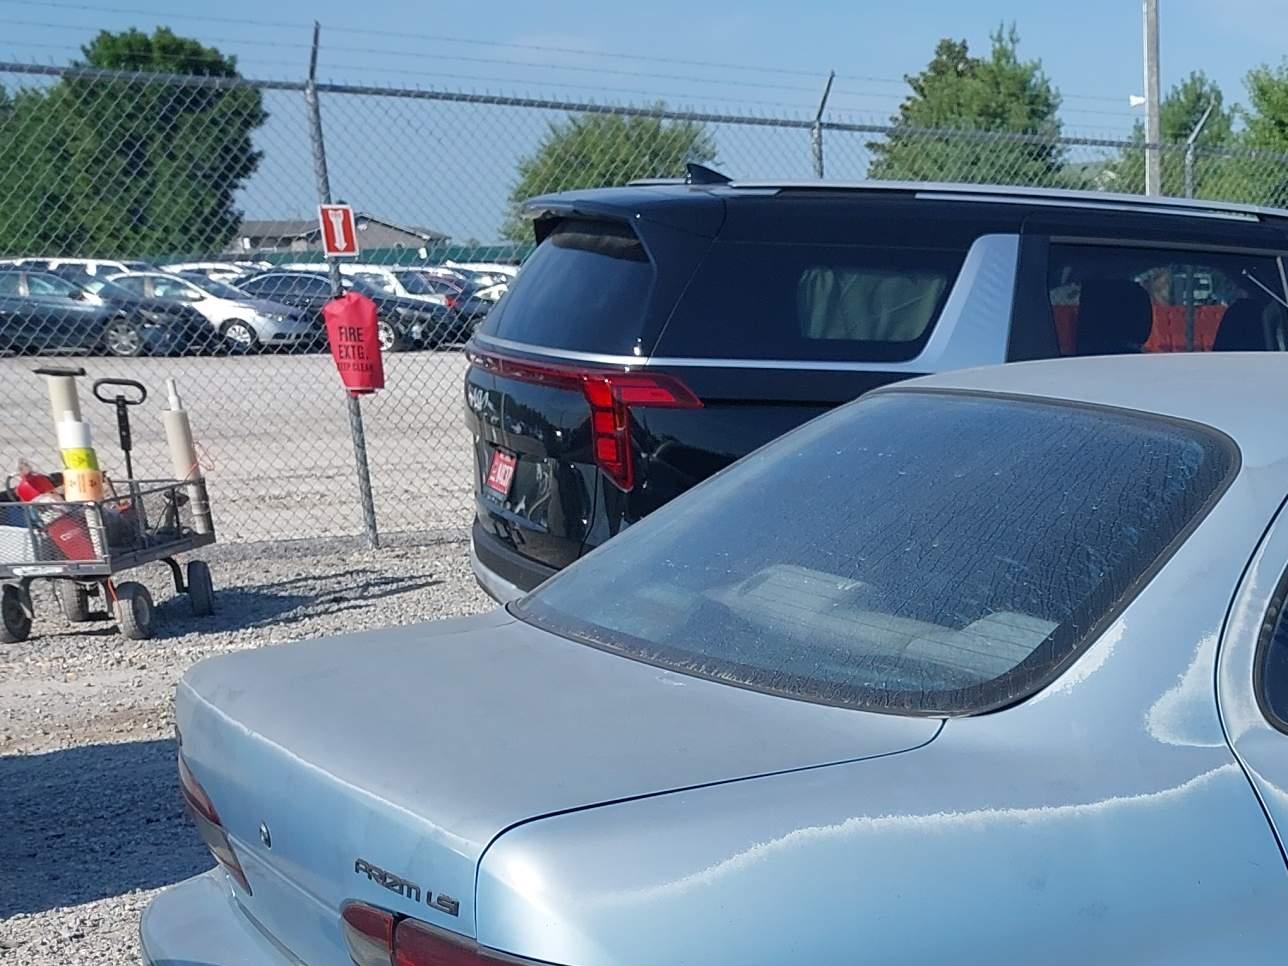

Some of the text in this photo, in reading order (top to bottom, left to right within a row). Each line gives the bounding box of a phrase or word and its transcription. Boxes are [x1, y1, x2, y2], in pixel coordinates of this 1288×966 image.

[338, 326, 364, 342] FIRE
[338, 344, 369, 360] EXTG.
[355, 858, 421, 903] PRIZM
